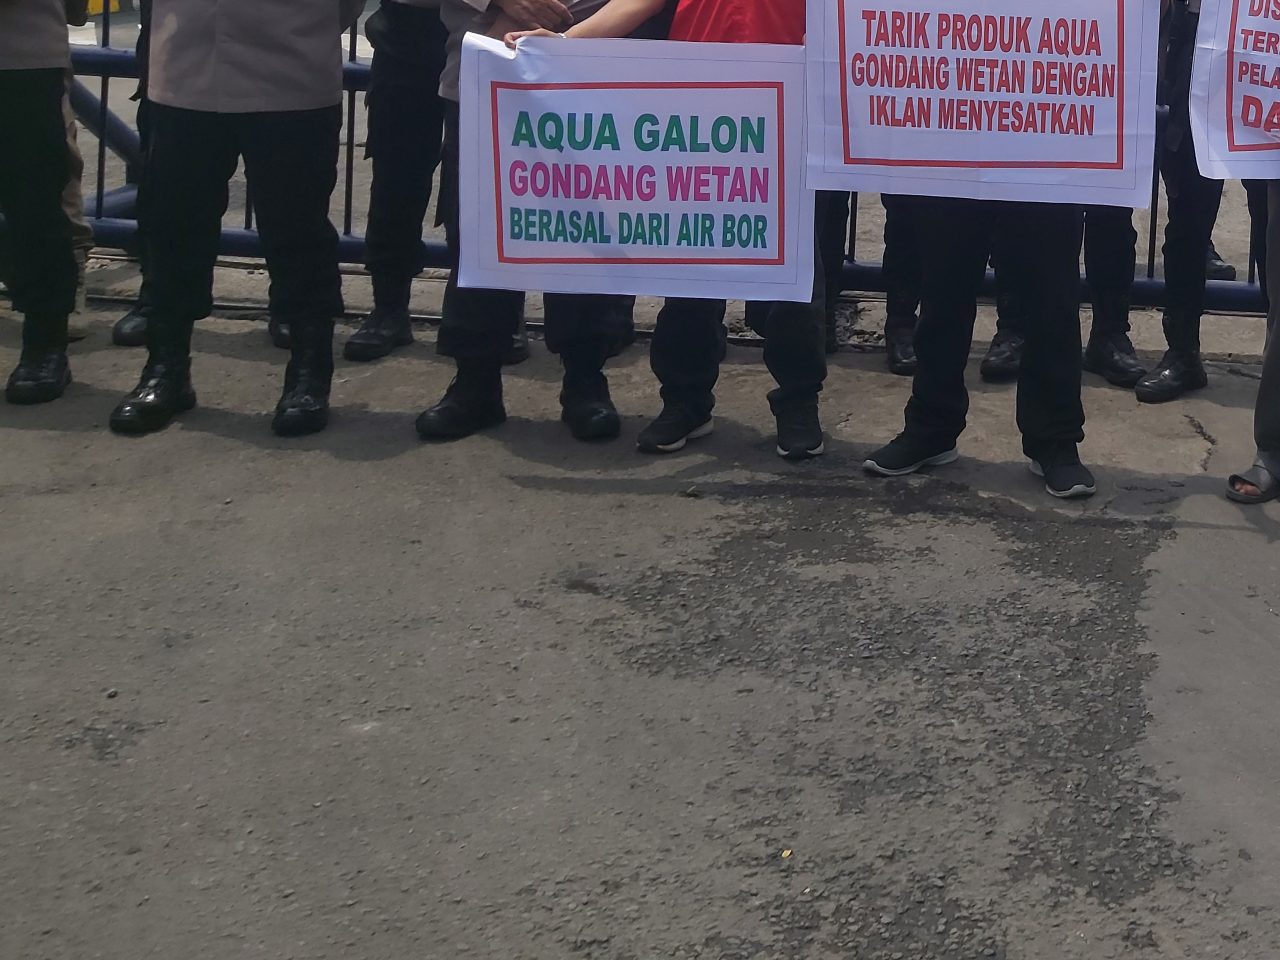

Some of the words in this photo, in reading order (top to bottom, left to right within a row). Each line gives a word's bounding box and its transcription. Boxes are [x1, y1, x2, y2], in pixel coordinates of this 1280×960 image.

[862, 9, 931, 49] TARIK
[937, 13, 1032, 54] PRODUK
[1037, 17, 1102, 58] AQUA
[851, 52, 949, 90] GONDANG
[955, 57, 1026, 94] WETAN
[1031, 60, 1116, 98] DENGAN
[511, 110, 620, 153] AQUA
[633, 113, 766, 154] GALON
[869, 95, 932, 128] IKLAN
[937, 97, 1095, 136] MENYESATKAN
[509, 159, 656, 202] GONDANG
[666, 165, 769, 204] WETAN
[509, 207, 611, 246] BERASAL
[618, 211, 670, 247] DARI
[676, 213, 715, 247] AIR
[721, 214, 768, 249] BOR
